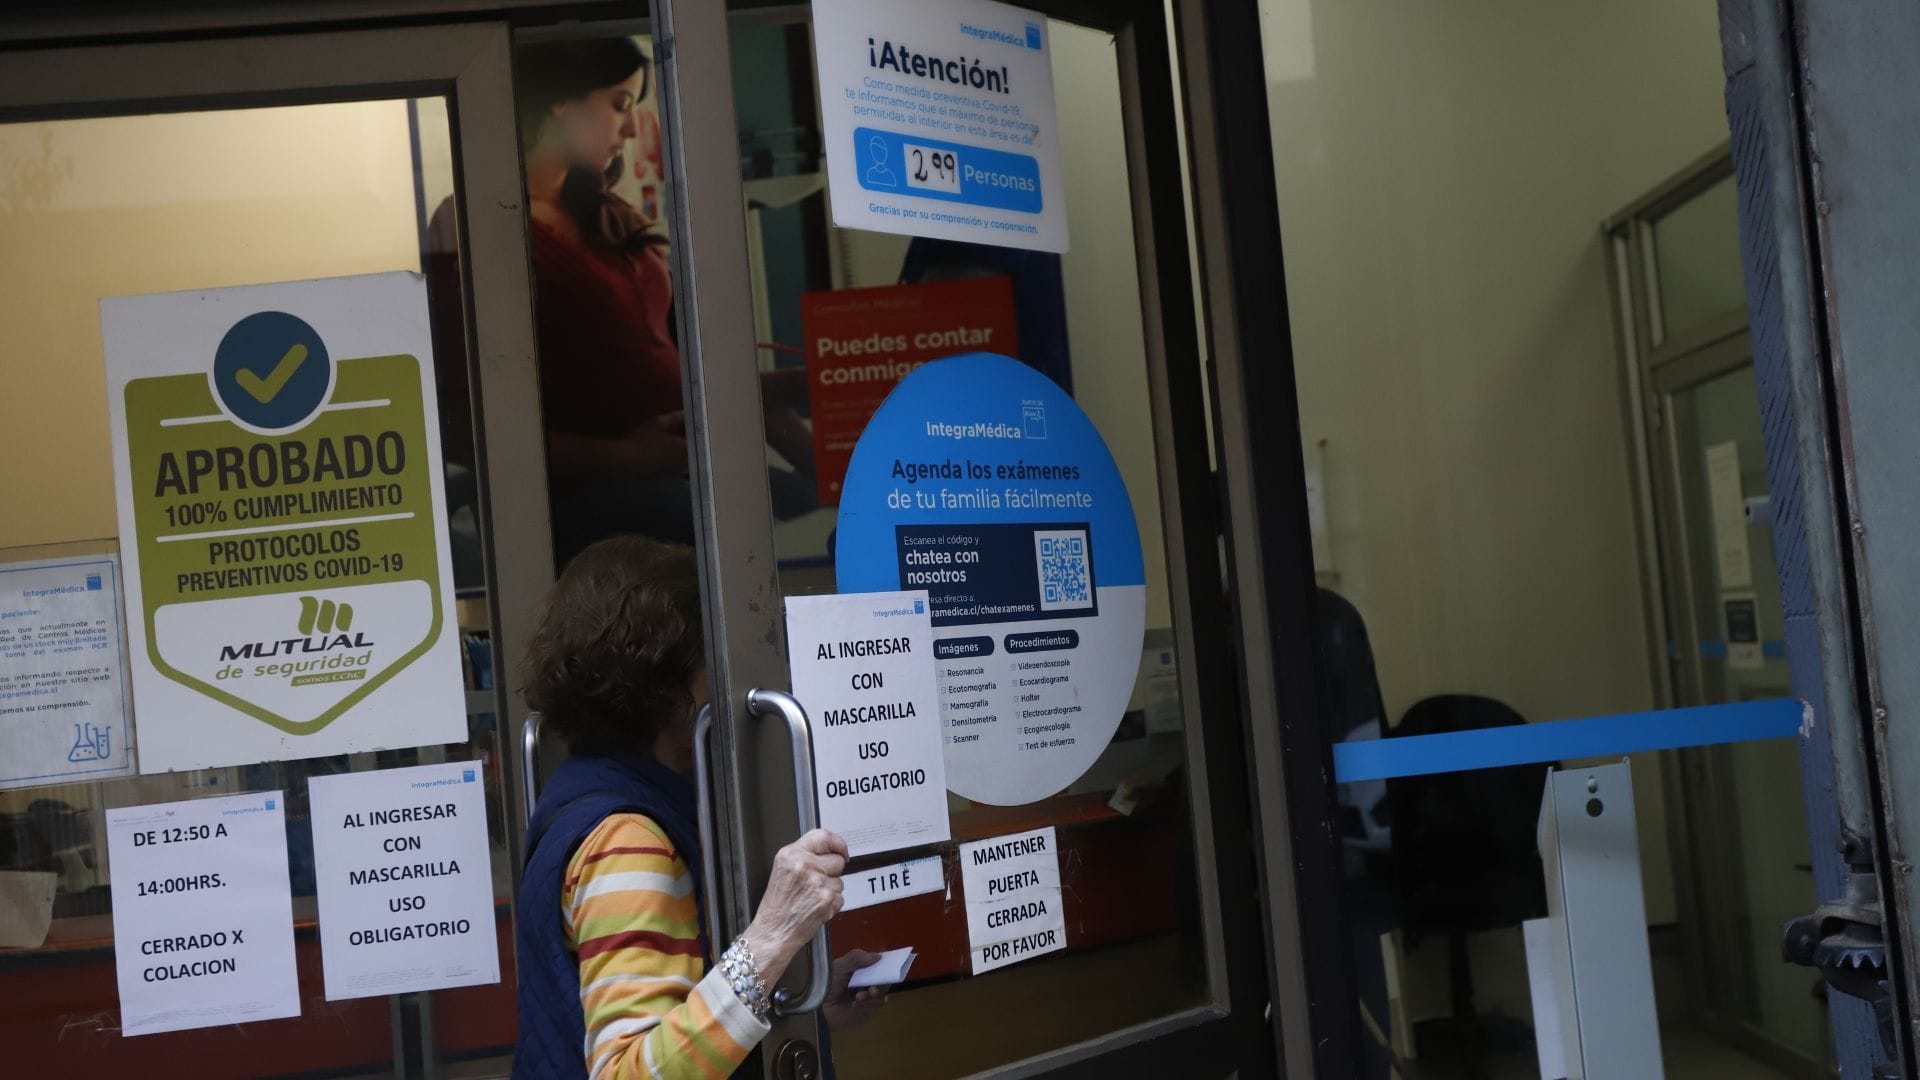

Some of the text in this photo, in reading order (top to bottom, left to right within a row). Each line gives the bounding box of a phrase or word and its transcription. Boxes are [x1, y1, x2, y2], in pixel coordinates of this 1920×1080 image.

[868, 37, 1009, 94] ¡Atención!
[864, 77, 893, 92] Como
[896, 83, 930, 99] medida
[934, 89, 980, 109] preventiva
[846, 88, 855, 98] te
[858, 90, 915, 110] informamos
[918, 103, 936, 115] que
[939, 105, 945, 115] el
[950, 108, 984, 124] máximo
[987, 114, 999, 125] de
[854, 105, 904, 122] permitidas
[908, 111, 916, 125] al
[919, 115, 951, 130] interior
[955, 123, 965, 132] en
[968, 125, 986, 138] esta
[1010, 133, 1020, 142] es
[913, 149, 955, 183] 299
[964, 165, 1035, 192] Personas
[869, 203, 1038, 234] Gracias por su comprensión y cooperación.
[817, 326, 993, 358] Puedes contar
[927, 421, 1020, 439] IntegraMédica
[155, 431, 407, 497] APROBADO
[892, 460, 1079, 484] Agenda los exámenes
[165, 484, 403, 528] 100% CUMPLIMIENTO
[887, 489, 1092, 509] de tu familia fácilmente
[208, 529, 361, 565] PROTOCOLOS
[904, 534, 979, 546] Escanea el código y
[906, 550, 978, 564] chatea con
[177, 553, 404, 593] PREVENTIVOS COVID-19
[908, 569, 967, 584] nosotros
[23, 585, 85, 598] IntegraMédica
[944, 595, 967, 603] directo
[931, 604, 1034, 617] ramedica.cl/chatexamenes
[18, 626, 32, 634] que
[40, 620, 88, 630] actualmente
[38, 631, 68, 639] Centros
[74, 626, 106, 635] Médicos
[35, 638, 56, 648] stock
[58, 639, 74, 647] muy
[75, 635, 106, 644] limitado
[54, 645, 83, 653] examen
[220, 633, 374, 661] MUTUAL
[817, 637, 911, 660] AL INGRESAR
[939, 642, 978, 656] Imágenes
[1010, 636, 1070, 650] Procedimientos
[14, 671, 61, 681] informando
[65, 667, 100, 676] respecto
[216, 650, 372, 680] de seguridad
[947, 666, 984, 678] Resonancia
[35, 679, 66, 687] nuestro
[93, 674, 109, 682] web
[296, 670, 362, 685] somos CChC
[851, 672, 883, 691] CON
[1020, 676, 1068, 687] Ecocardiograma
[26, 705, 35, 713] su
[37, 700, 91, 712] comprensión.
[1021, 693, 1040, 702] Holter
[824, 701, 916, 727] MASCARILLA
[1022, 706, 1082, 719] Electrocardiograma
[953, 733, 979, 743] Scanner
[1026, 737, 1075, 750] Test de esfuerzo
[858, 741, 889, 759] USO
[411, 776, 462, 790] IntegraMédica
[826, 769, 925, 798] OBLIGATORIO
[343, 804, 456, 829] AL INGRESAR
[134, 823, 228, 847] DE 12:50 A
[383, 836, 421, 853] CON
[973, 836, 1045, 865] MANTENER
[350, 860, 460, 886] MASCARILLA
[989, 870, 1039, 895] PUERTA
[137, 874, 226, 897] 14:00HRS.
[389, 895, 425, 913] USO
[987, 900, 1047, 928] CERRADA
[141, 930, 244, 956] CERRADO X
[349, 919, 470, 946] OBLIGATORIO
[982, 929, 1055, 963] POR FAVOR
[144, 958, 235, 982] COLACION
